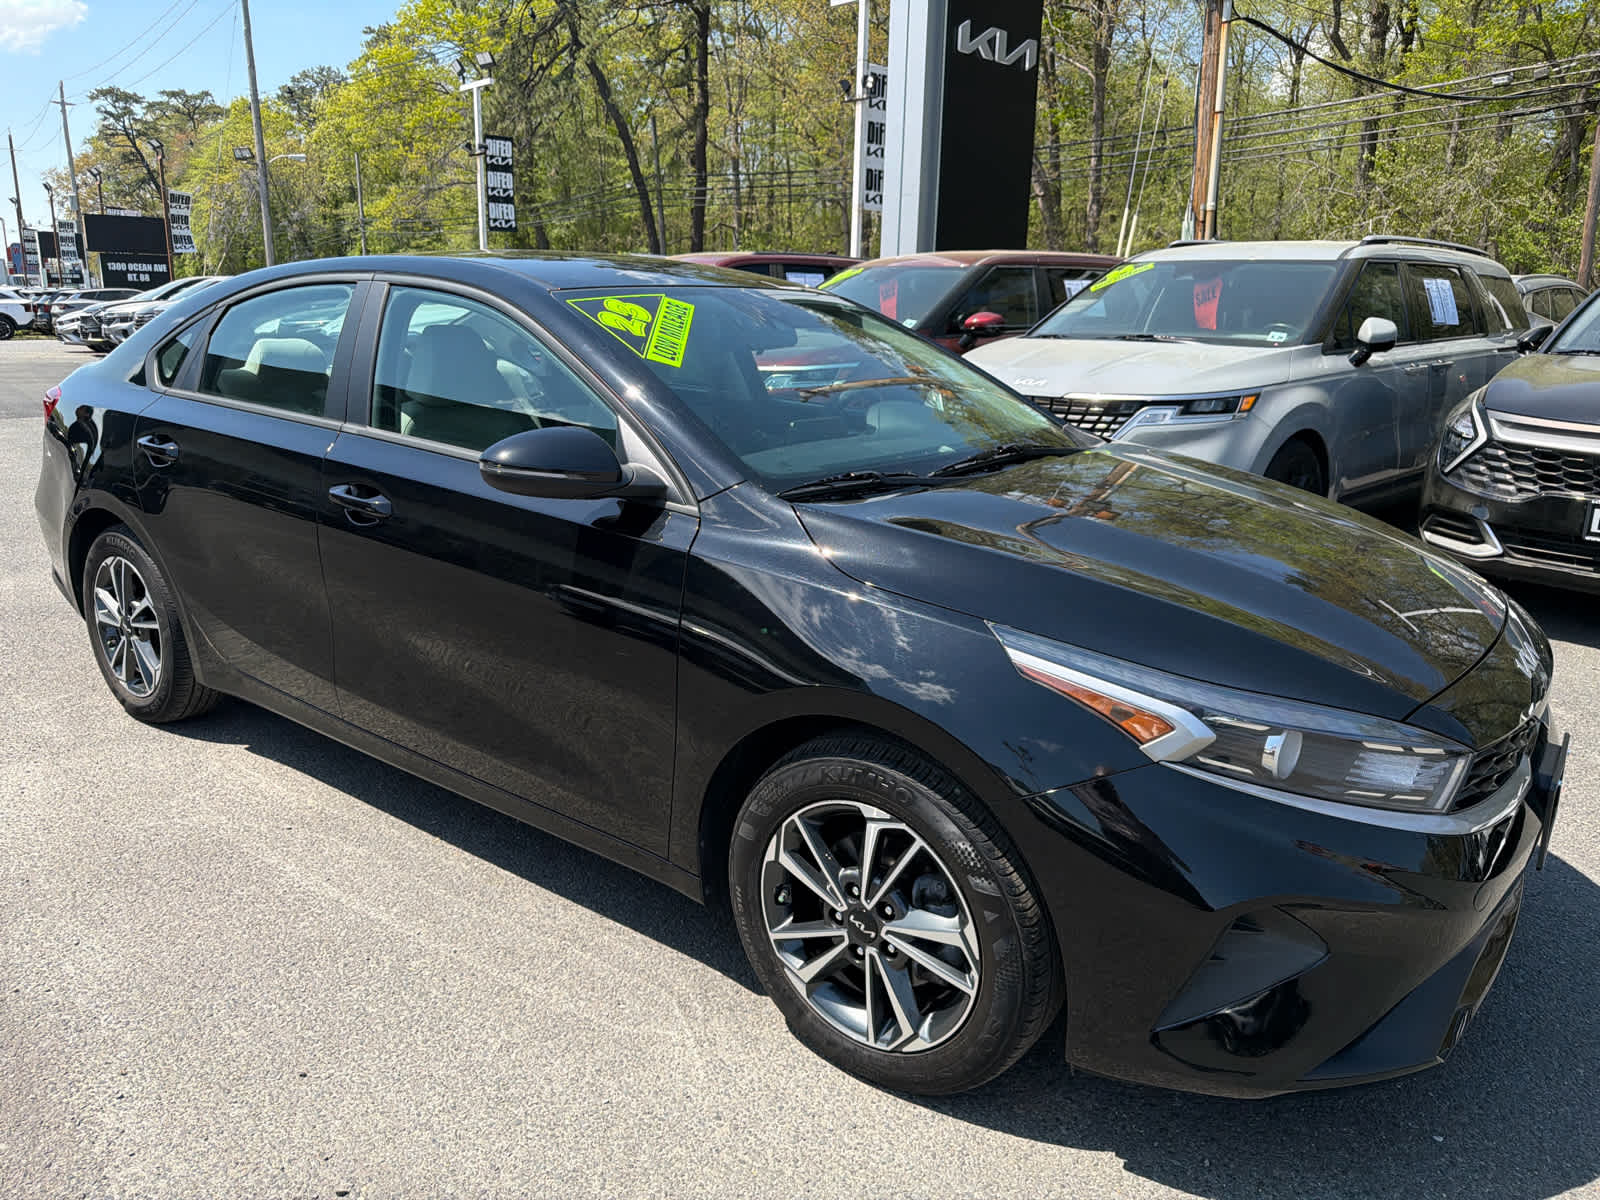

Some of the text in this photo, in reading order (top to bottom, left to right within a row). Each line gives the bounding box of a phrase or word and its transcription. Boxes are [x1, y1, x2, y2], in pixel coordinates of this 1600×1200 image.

[957, 19, 1039, 72] KIA
[868, 72, 888, 98] DiF
[868, 98, 887, 111] KI
[867, 120, 886, 145] DiF
[866, 146, 885, 158] KI
[865, 168, 884, 192] DiF
[865, 192, 883, 204] KI
[107, 262, 168, 273] 1300 OCEAN AVE
[597, 299, 652, 336] 23
[652, 301, 689, 361] LOW MILEAGE
